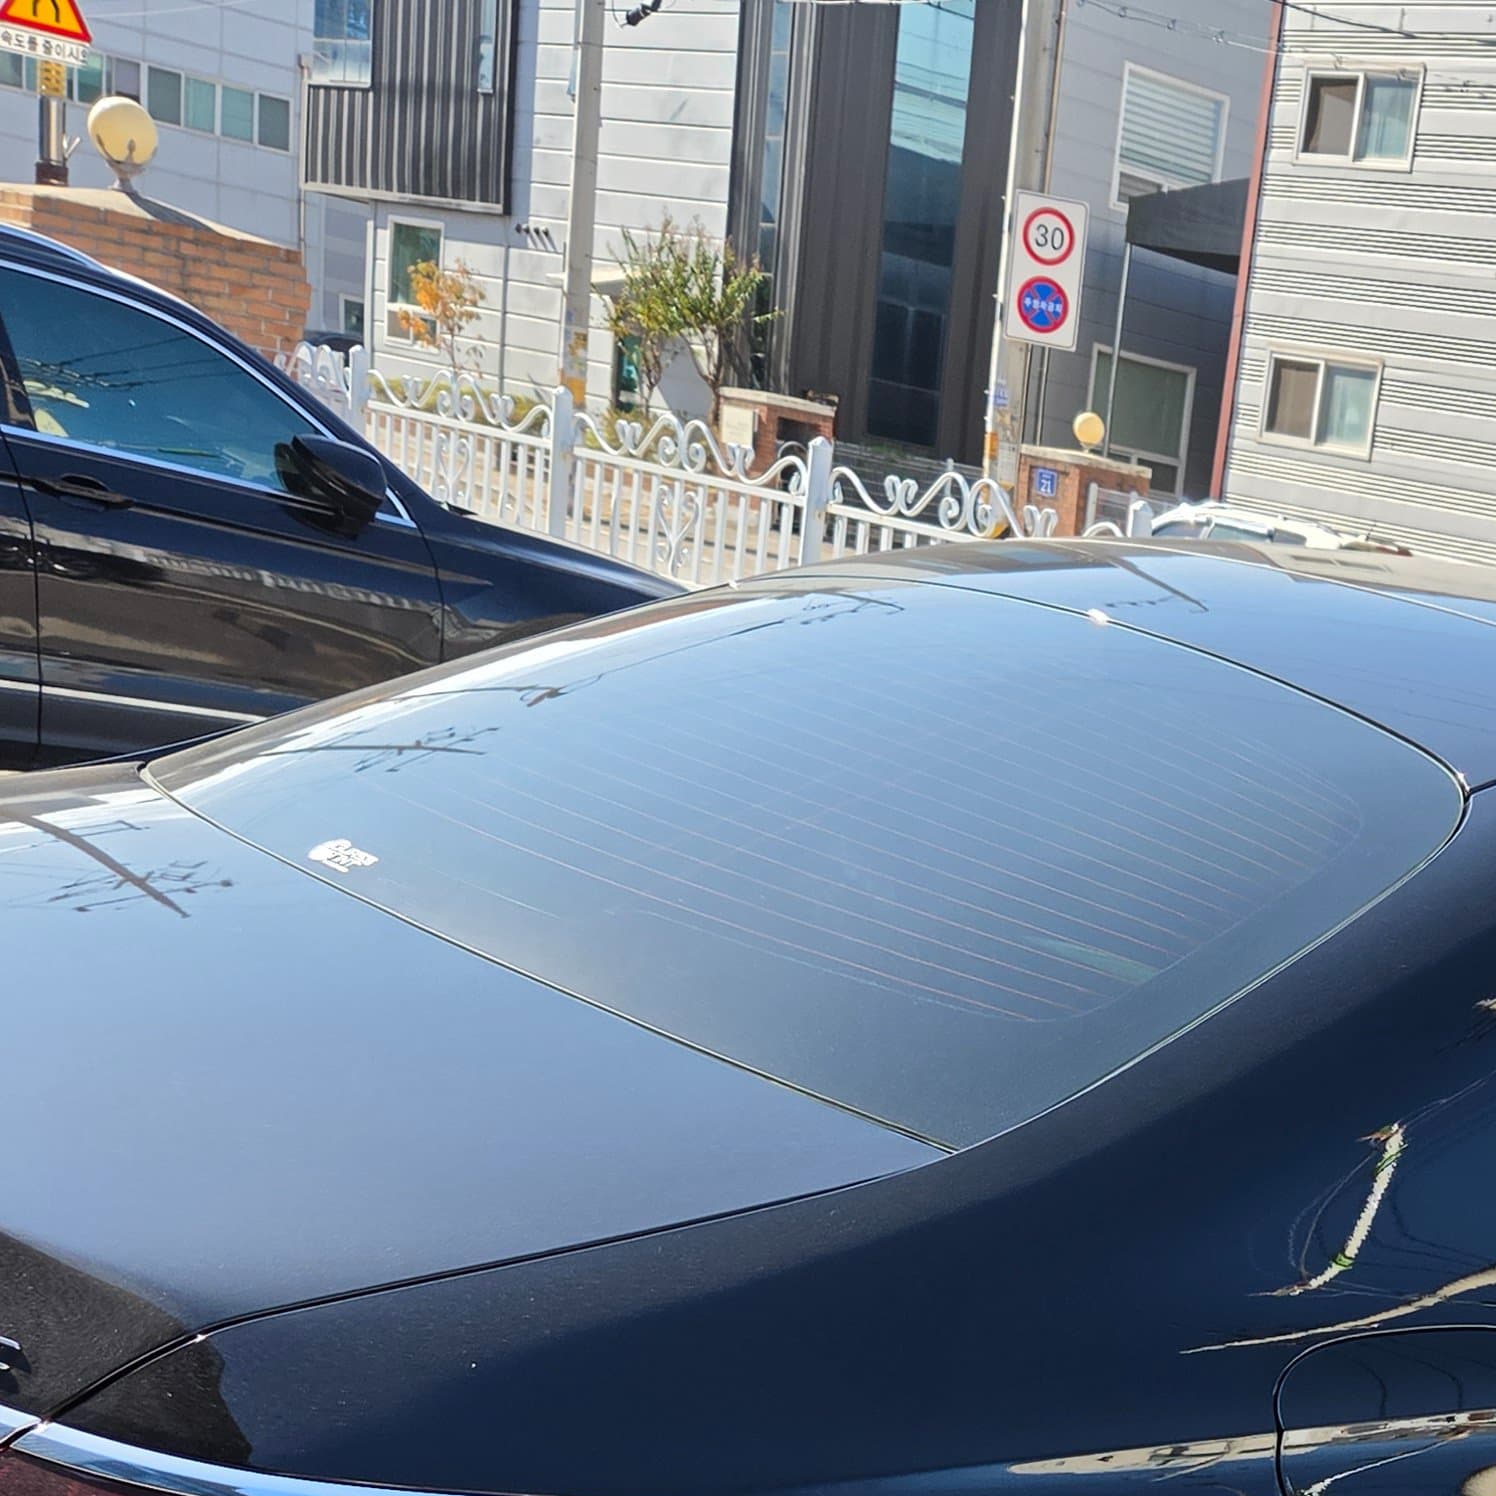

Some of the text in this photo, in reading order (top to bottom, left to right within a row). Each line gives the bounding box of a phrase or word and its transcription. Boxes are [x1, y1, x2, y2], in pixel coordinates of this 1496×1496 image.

[1, 30, 89, 64] 속도를 줄이시오
[1034, 223, 1065, 251] 30
